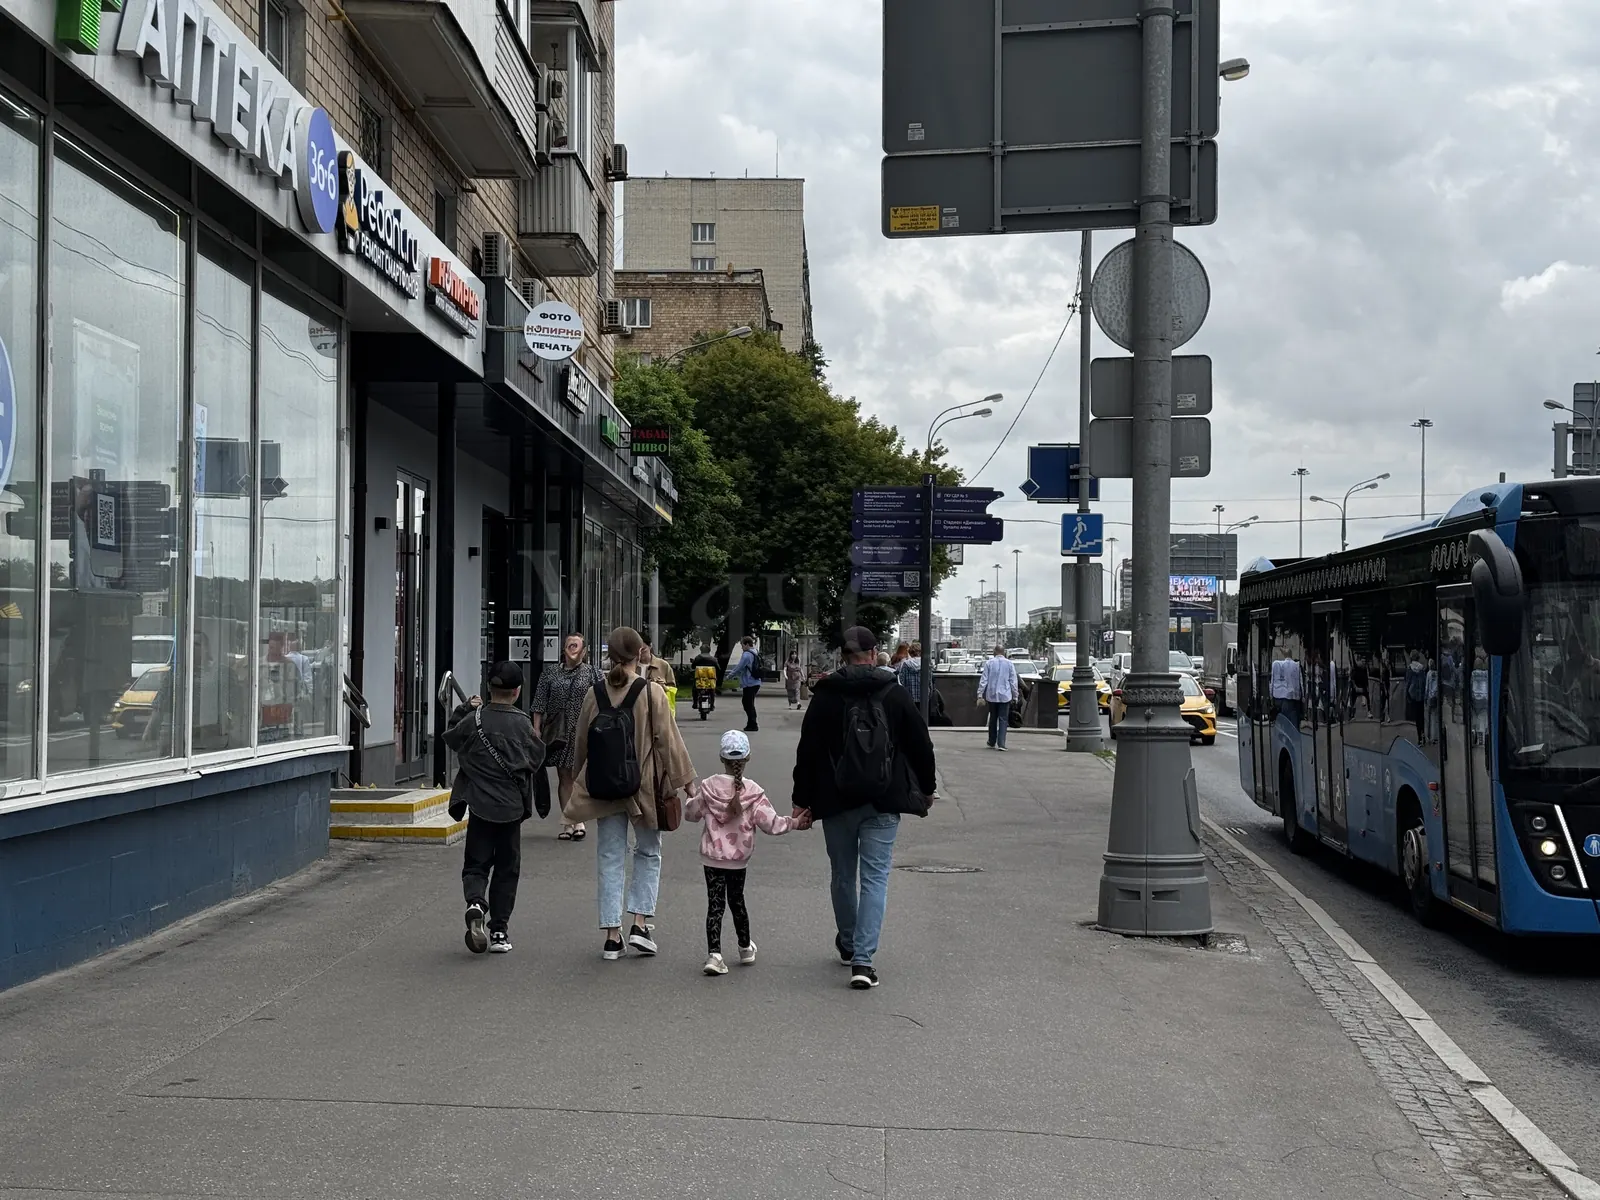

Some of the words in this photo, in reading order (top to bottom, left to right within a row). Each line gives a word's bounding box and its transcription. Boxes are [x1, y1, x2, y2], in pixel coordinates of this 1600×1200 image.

[117, 0, 300, 191] АПТЕКА
[360, 175, 420, 270] Pedant.ru
[361, 232, 385, 270] РЕМОНТ
[384, 252, 419, 300] СМАРТФОНОВ
[539, 312, 572, 322] ФОТО
[532, 341, 573, 352] ПЕЧАТЬ
[632, 428, 669, 440] ТАБАК
[632, 442, 668, 453] ПИВО
[1188, 577, 1213, 586] СИТИ
[512, 613, 557, 626] НАПКИ
